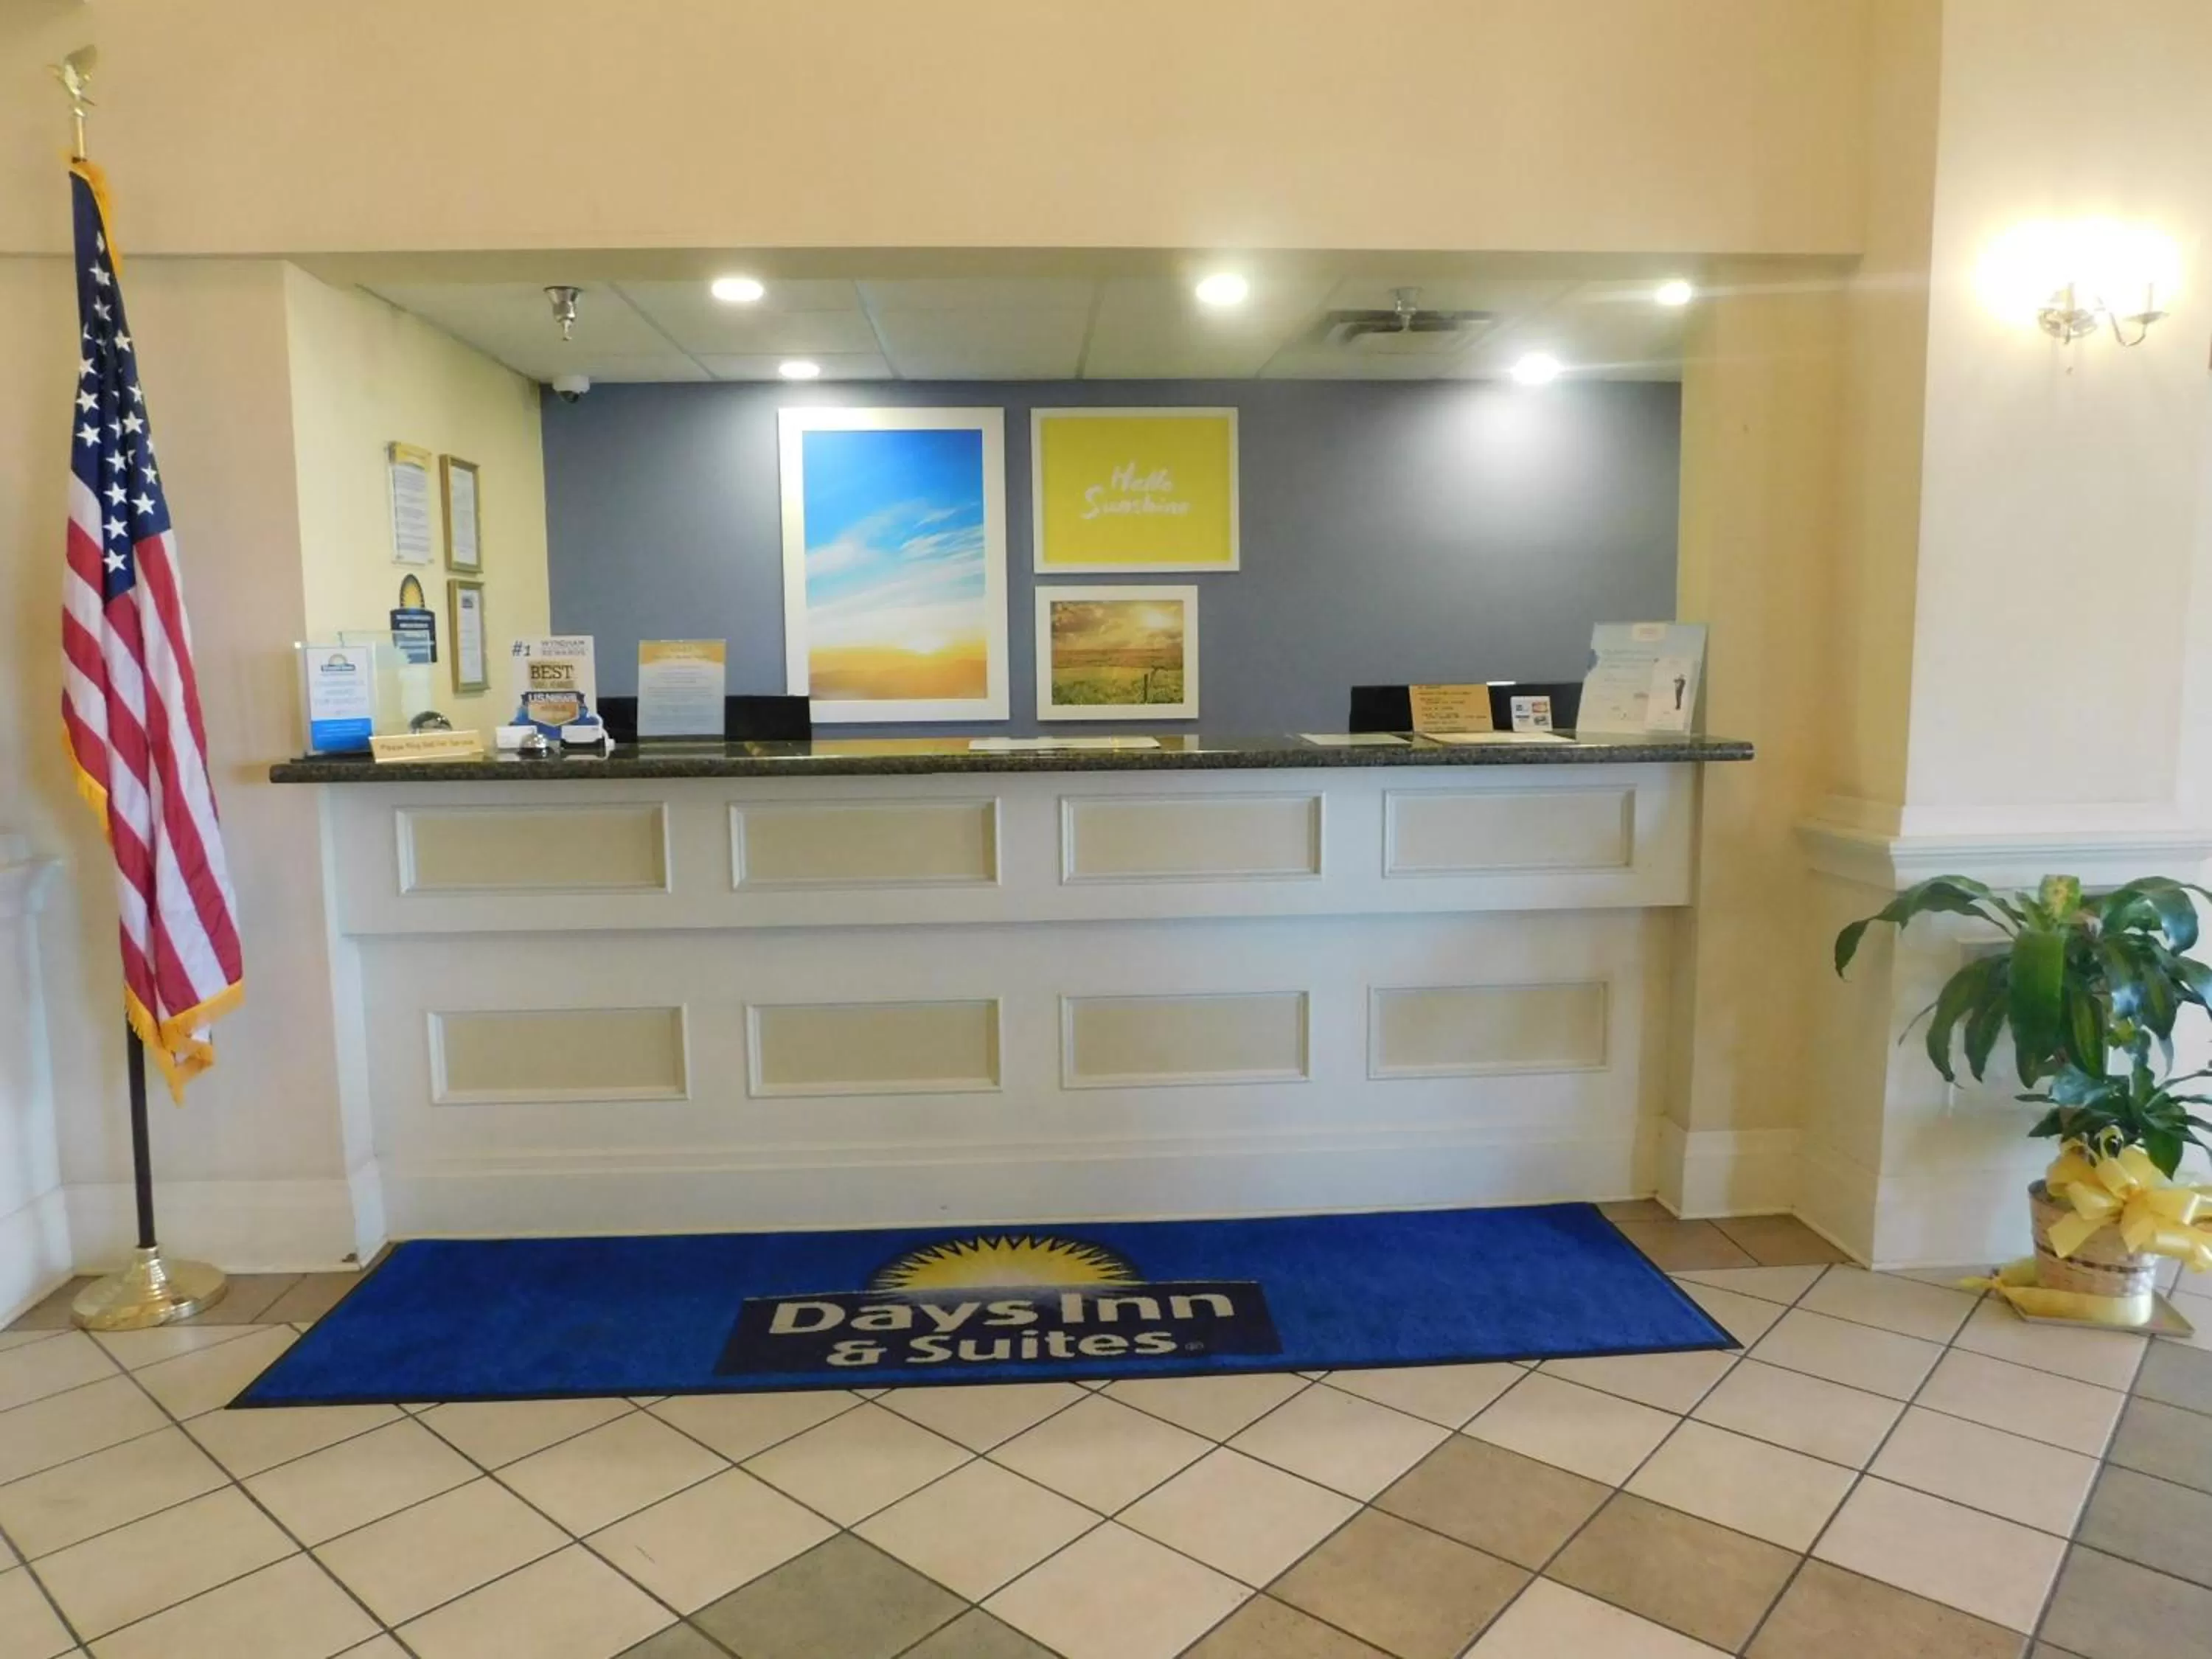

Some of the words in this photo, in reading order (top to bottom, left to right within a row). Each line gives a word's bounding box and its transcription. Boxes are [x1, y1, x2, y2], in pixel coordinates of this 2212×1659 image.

[1111, 462, 1173, 493] Hello
[1080, 484, 1192, 519] Sunshine
[512, 640, 531, 656] #1
[531, 664, 574, 679] BEST
[768, 1296, 1040, 1333] Days
[1060, 1292, 1234, 1323] Inn
[826, 1340, 887, 1366] &
[905, 1329, 1178, 1363] Suites
